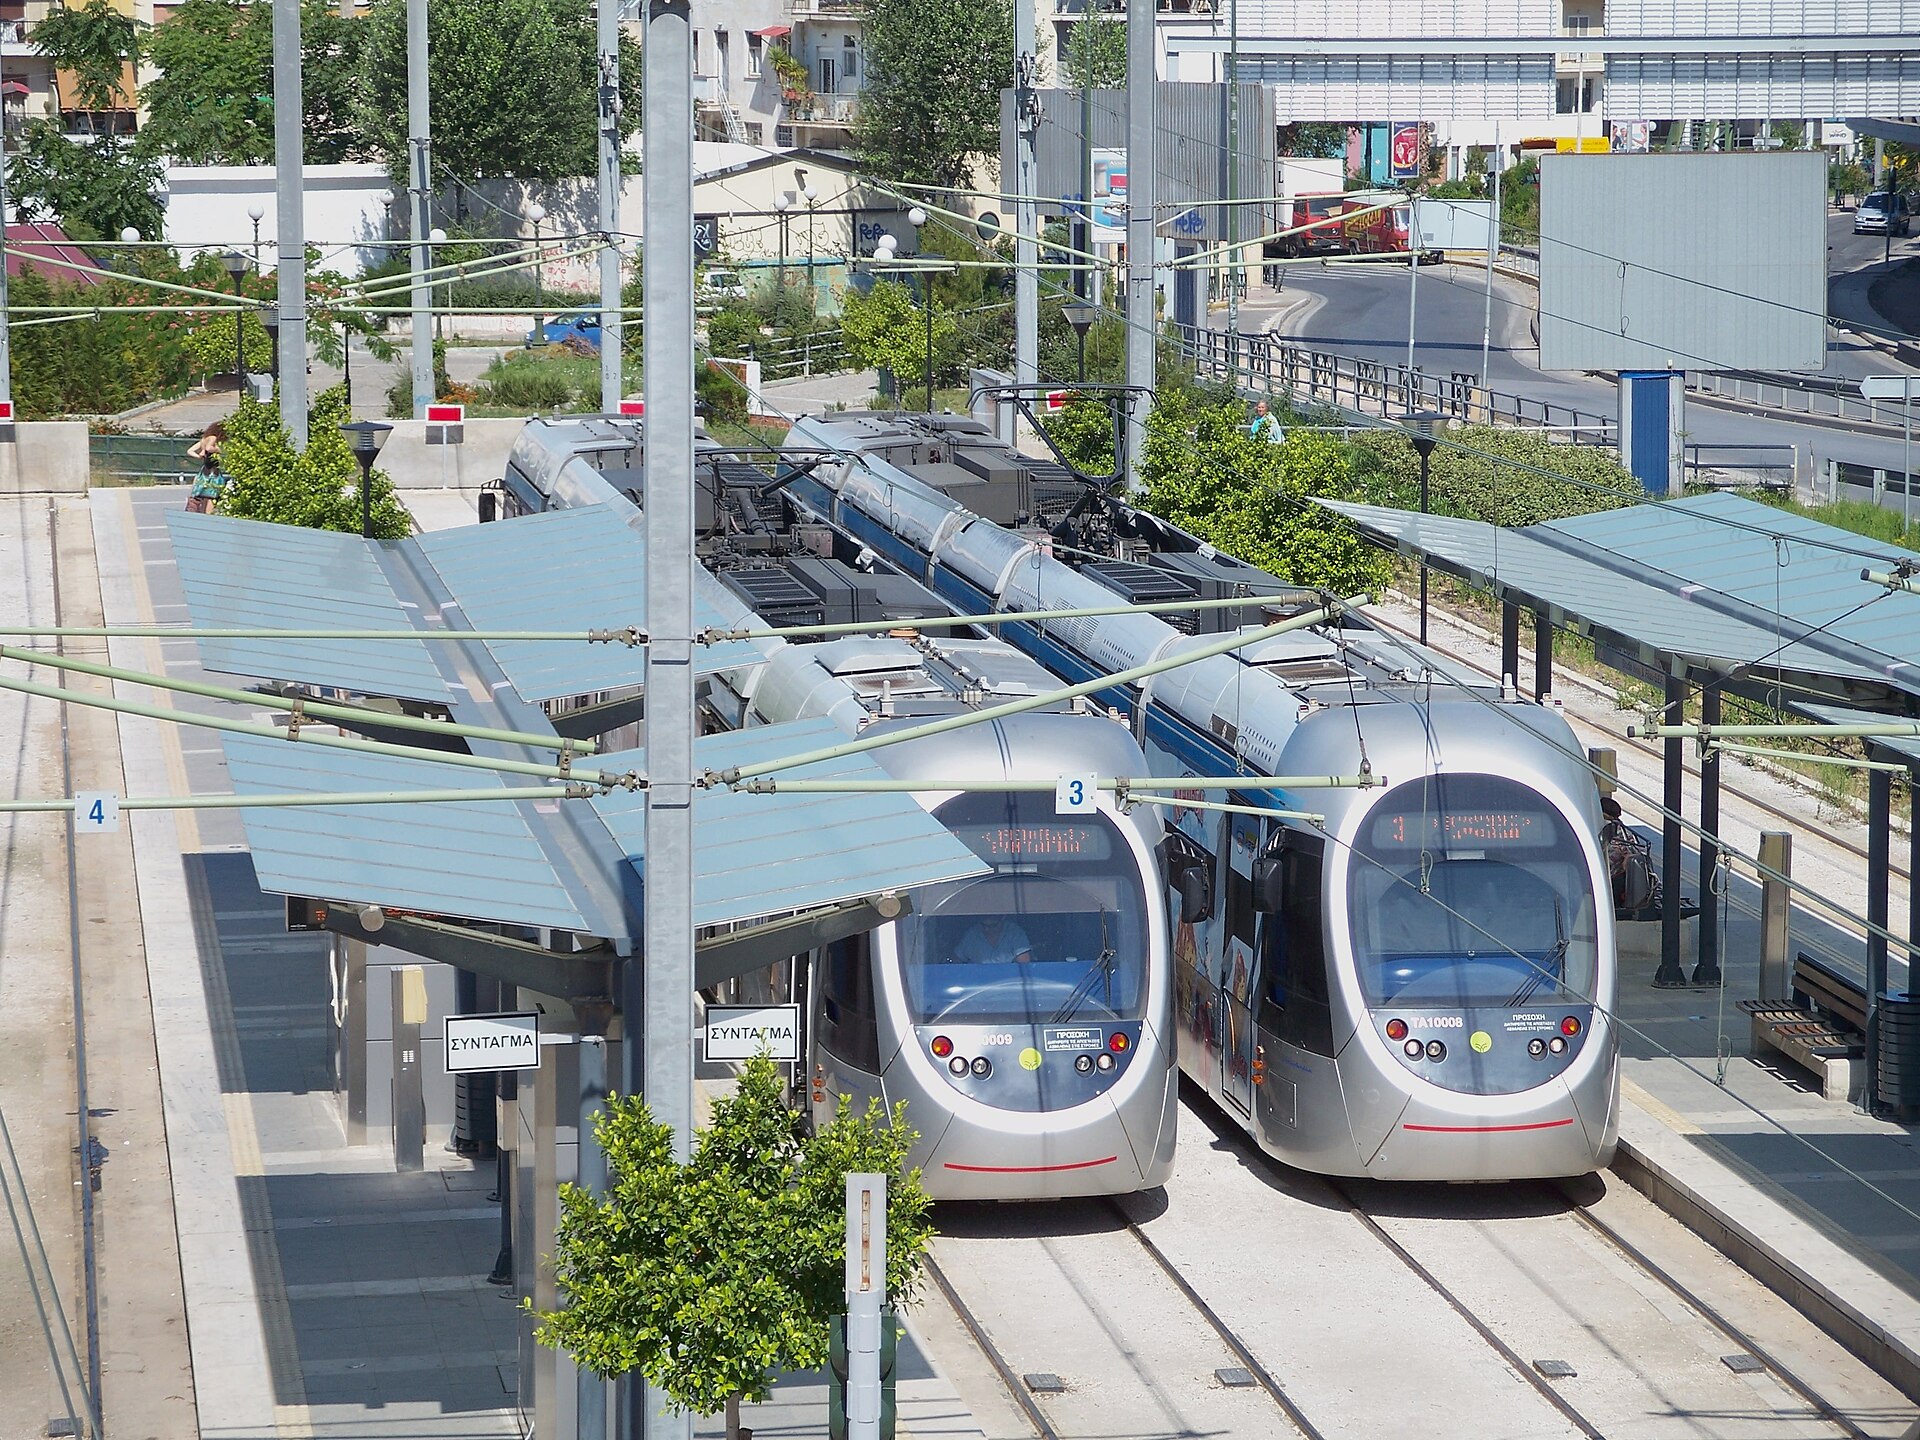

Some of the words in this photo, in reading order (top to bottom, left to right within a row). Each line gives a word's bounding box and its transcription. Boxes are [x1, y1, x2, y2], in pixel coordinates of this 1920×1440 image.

[1069, 780, 1084, 806] 3
[88, 799, 105, 825] 4
[1411, 1016, 1464, 1029] TA10008
[1512, 1013, 1546, 1021] ΠΡΟΣΟΧΗ
[450, 1034, 533, 1051] ΣΥΝΤΑΓΜΑ
[1056, 1031, 1090, 1039] ΠΡΟΣΟΧΗ
